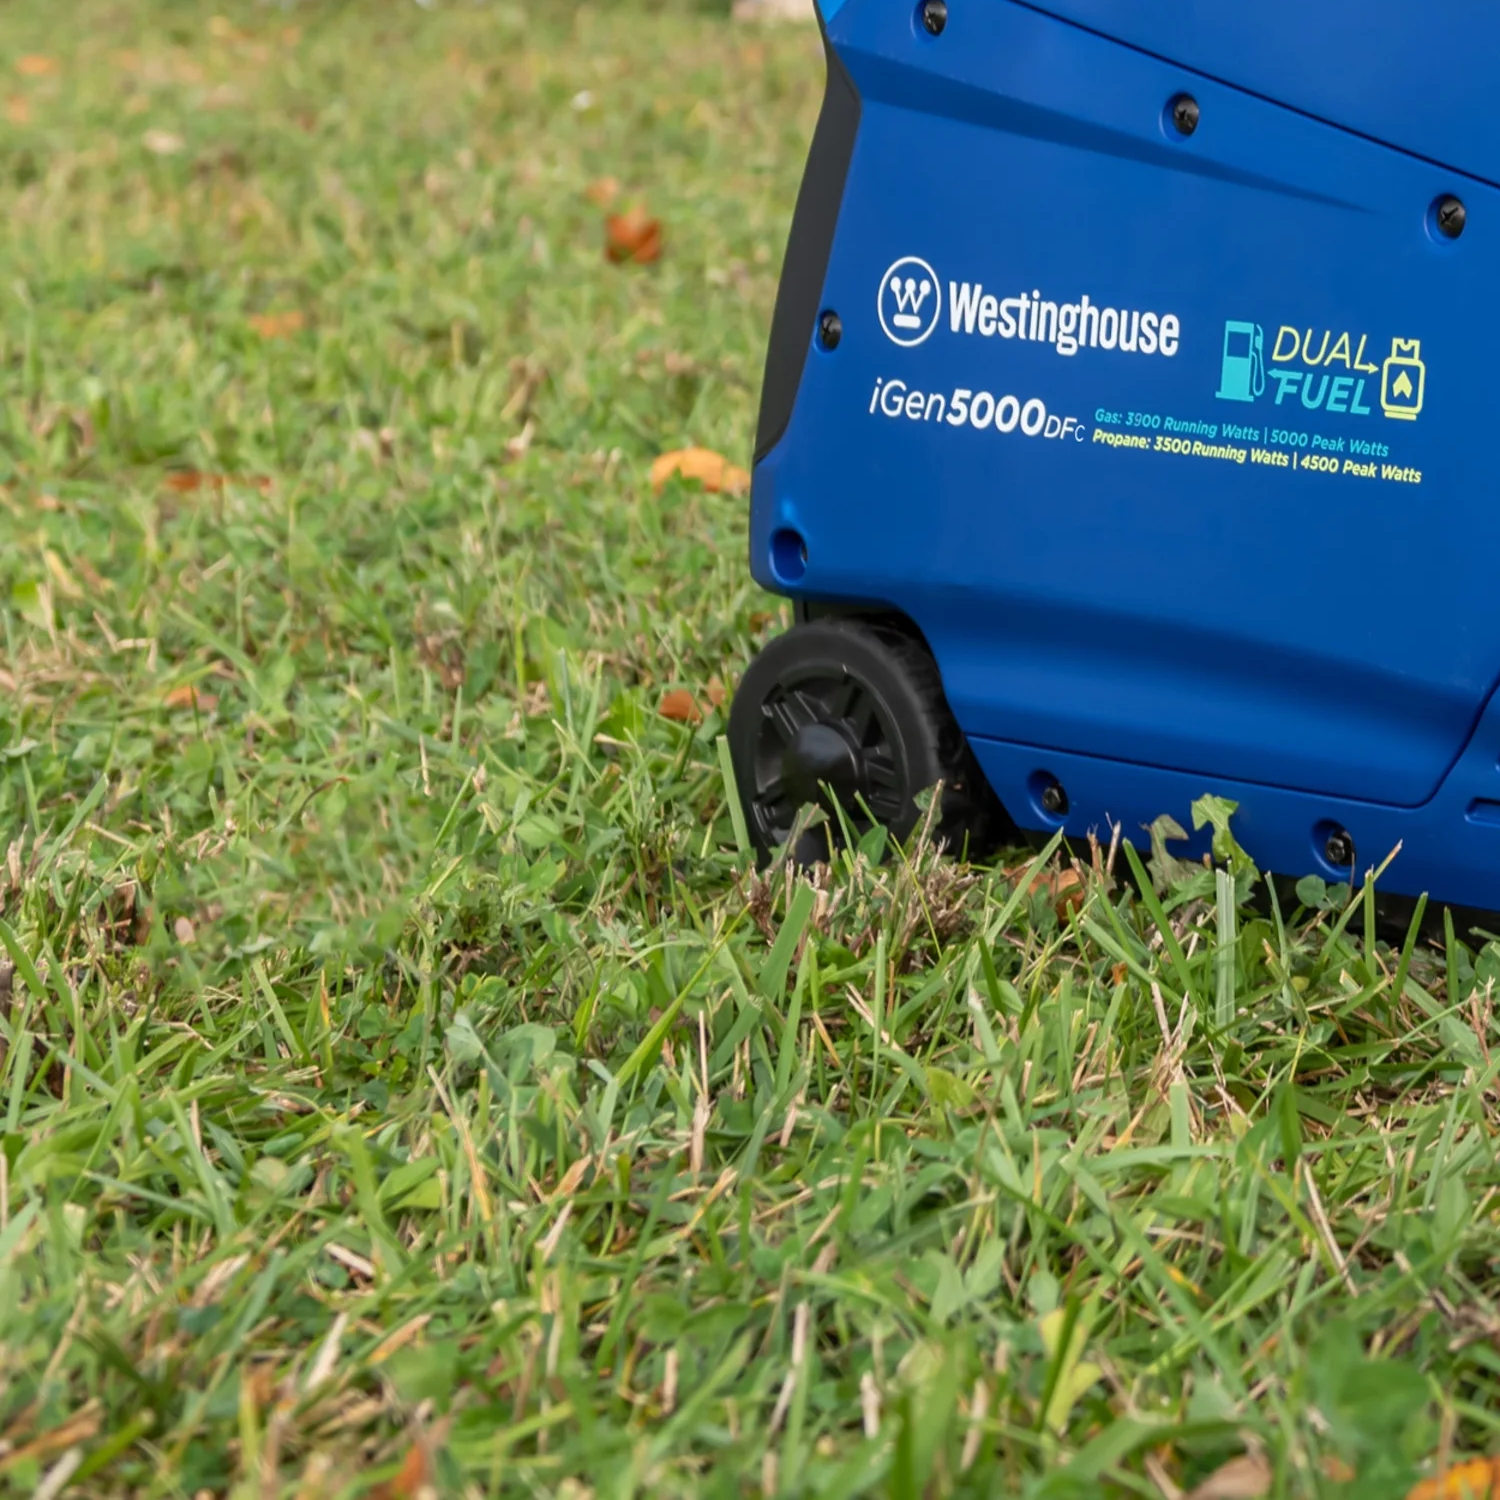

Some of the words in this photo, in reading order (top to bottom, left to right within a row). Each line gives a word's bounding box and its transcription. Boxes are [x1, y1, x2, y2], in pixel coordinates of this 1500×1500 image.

[949, 281, 1180, 357] Westinghouse
[1272, 325, 1379, 374] DUAL
[1267, 368, 1370, 415] FUEL
[1092, 428, 1151, 448] Propane:
[1153, 436, 1191, 455] 3500
[1192, 440, 1247, 464] Running
[1250, 448, 1289, 467] Watts
[1300, 454, 1339, 473] 4500
[1343, 459, 1378, 478] Peak
[1381, 464, 1422, 484] Watts
[1095, 408, 1123, 424] Gas:
[1125, 411, 1161, 429] 3900
[1164, 417, 1218, 439] Running
[1222, 423, 1260, 441] Watts
[1270, 429, 1308, 447] 5000
[1311, 434, 1345, 452] Peak
[1350, 439, 1389, 457] Watts
